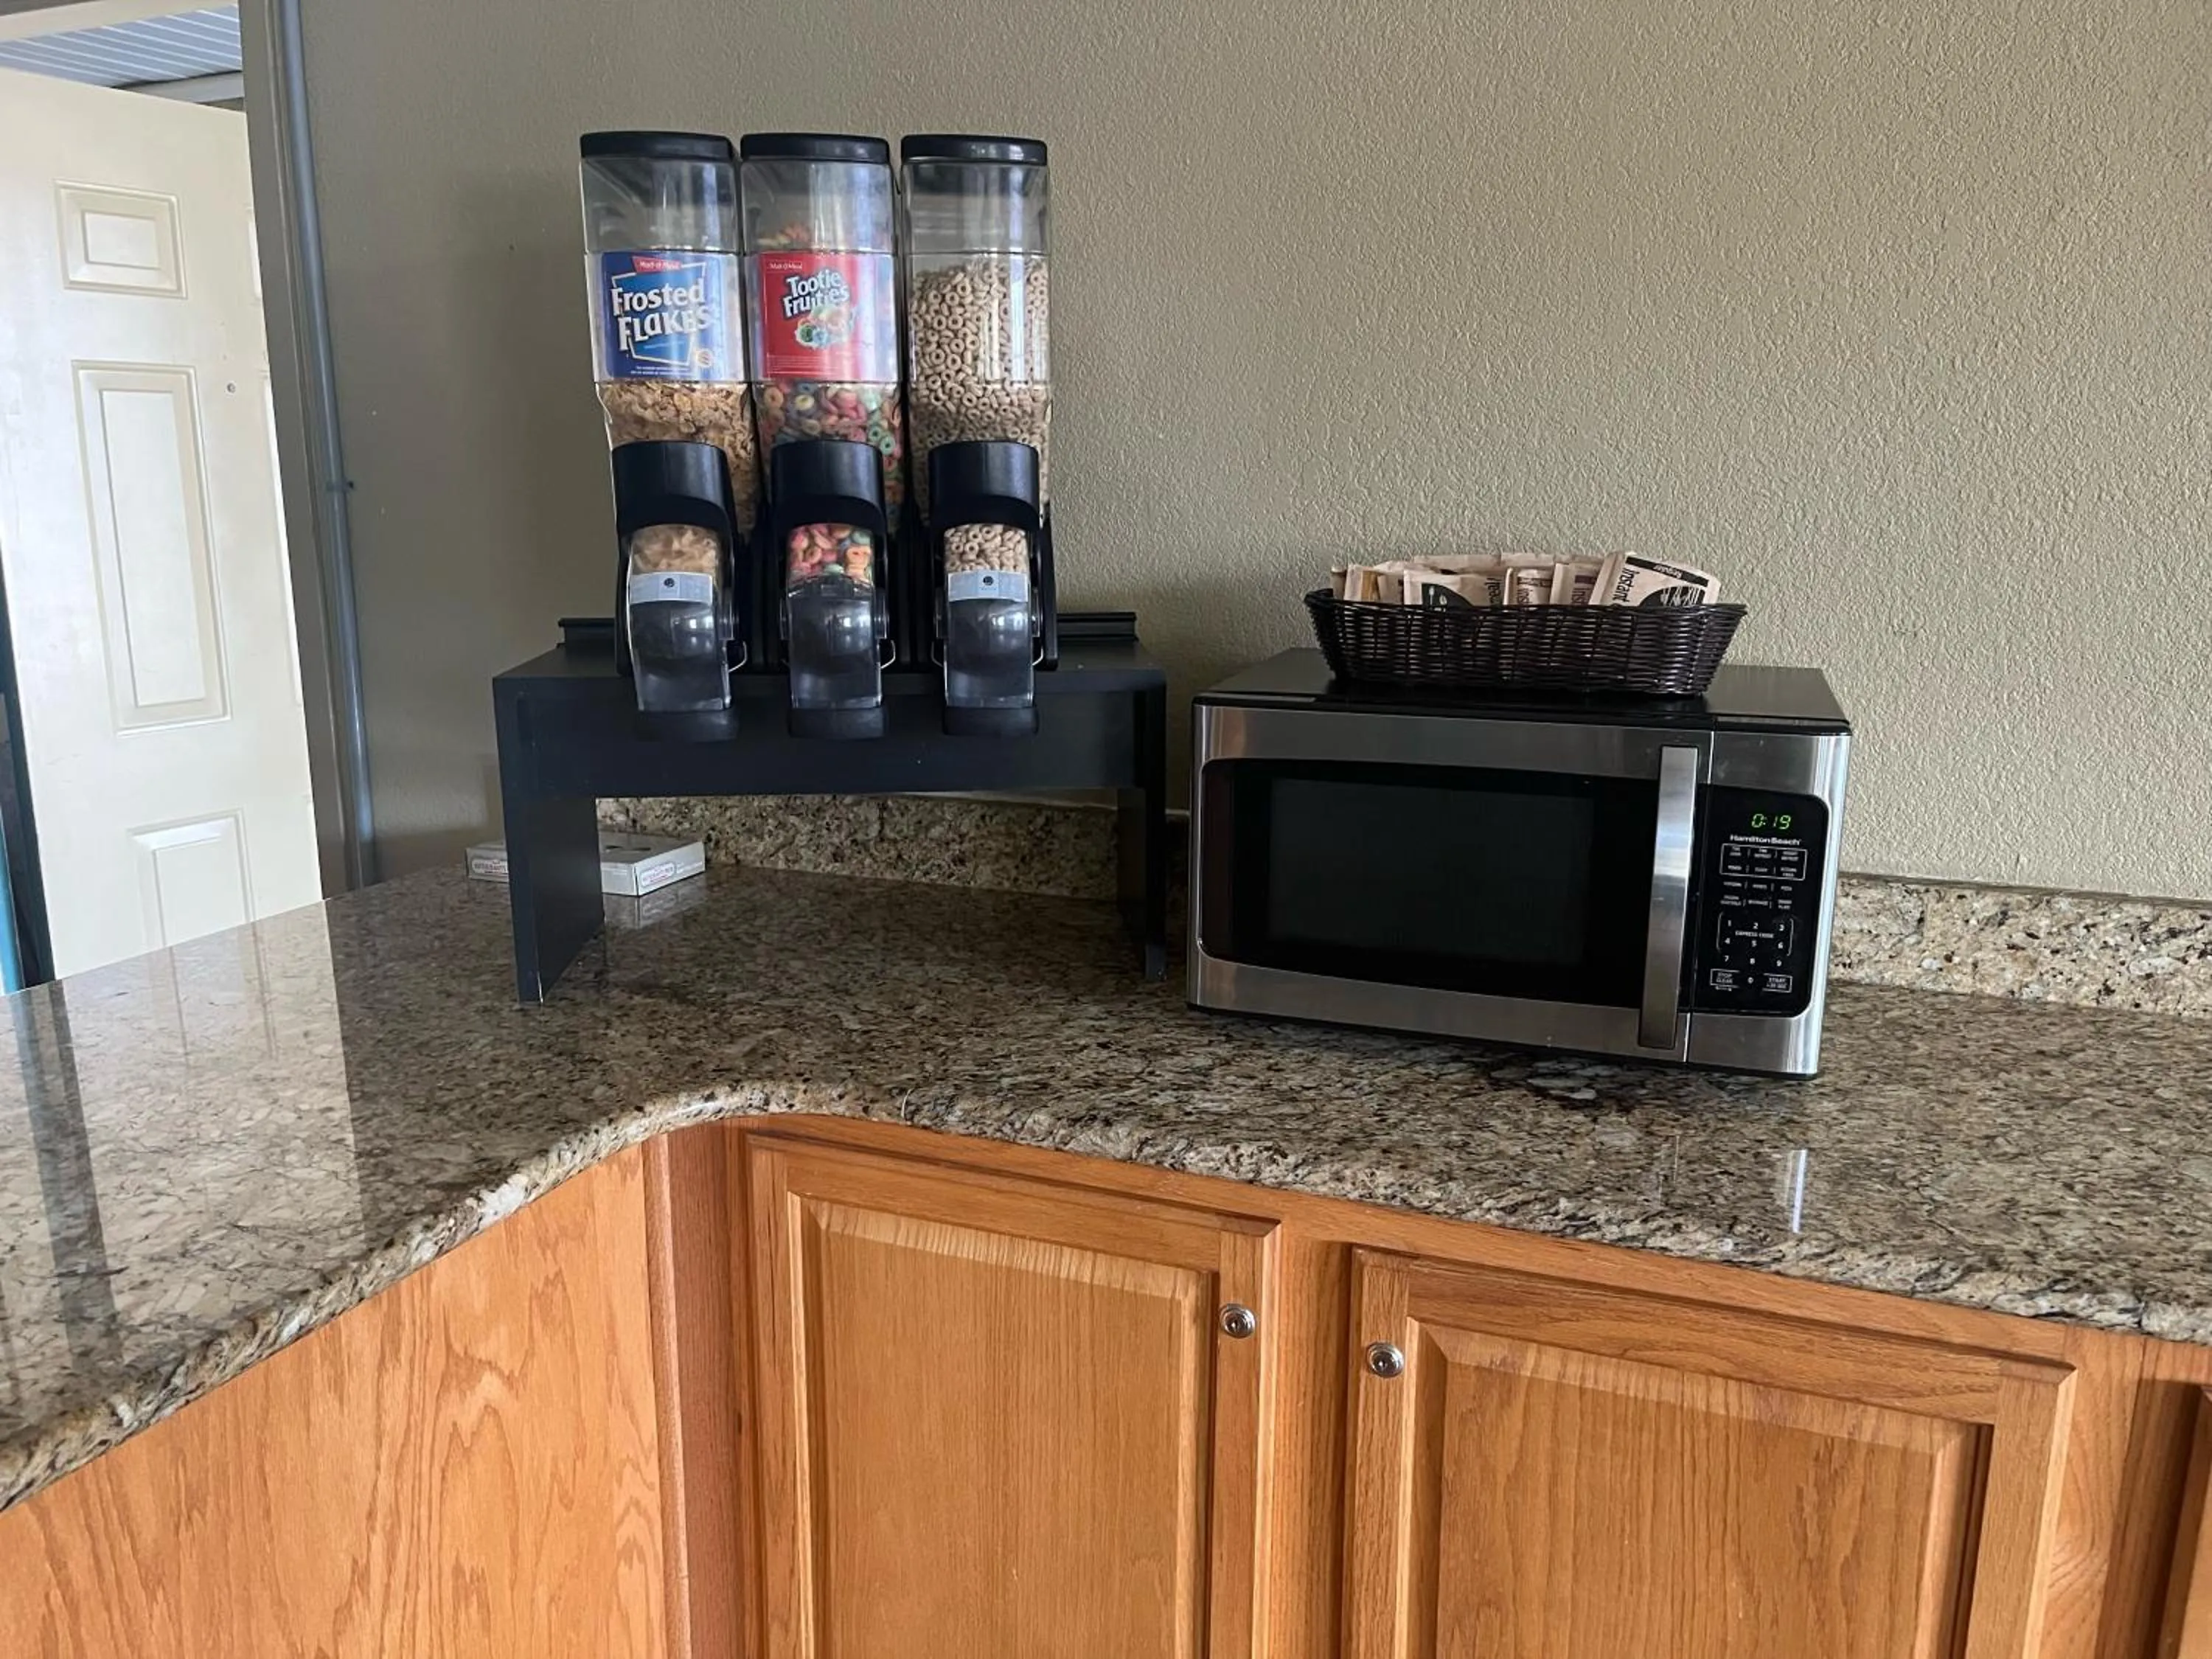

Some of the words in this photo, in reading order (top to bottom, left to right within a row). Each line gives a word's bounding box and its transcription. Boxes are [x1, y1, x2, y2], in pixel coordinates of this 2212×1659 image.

[611, 277, 706, 316] Frosted
[785, 268, 842, 298] Tootie
[782, 285, 850, 318] Fruities
[1752, 813, 1791, 830] 0:19
[1747, 976, 1754, 984] 0
